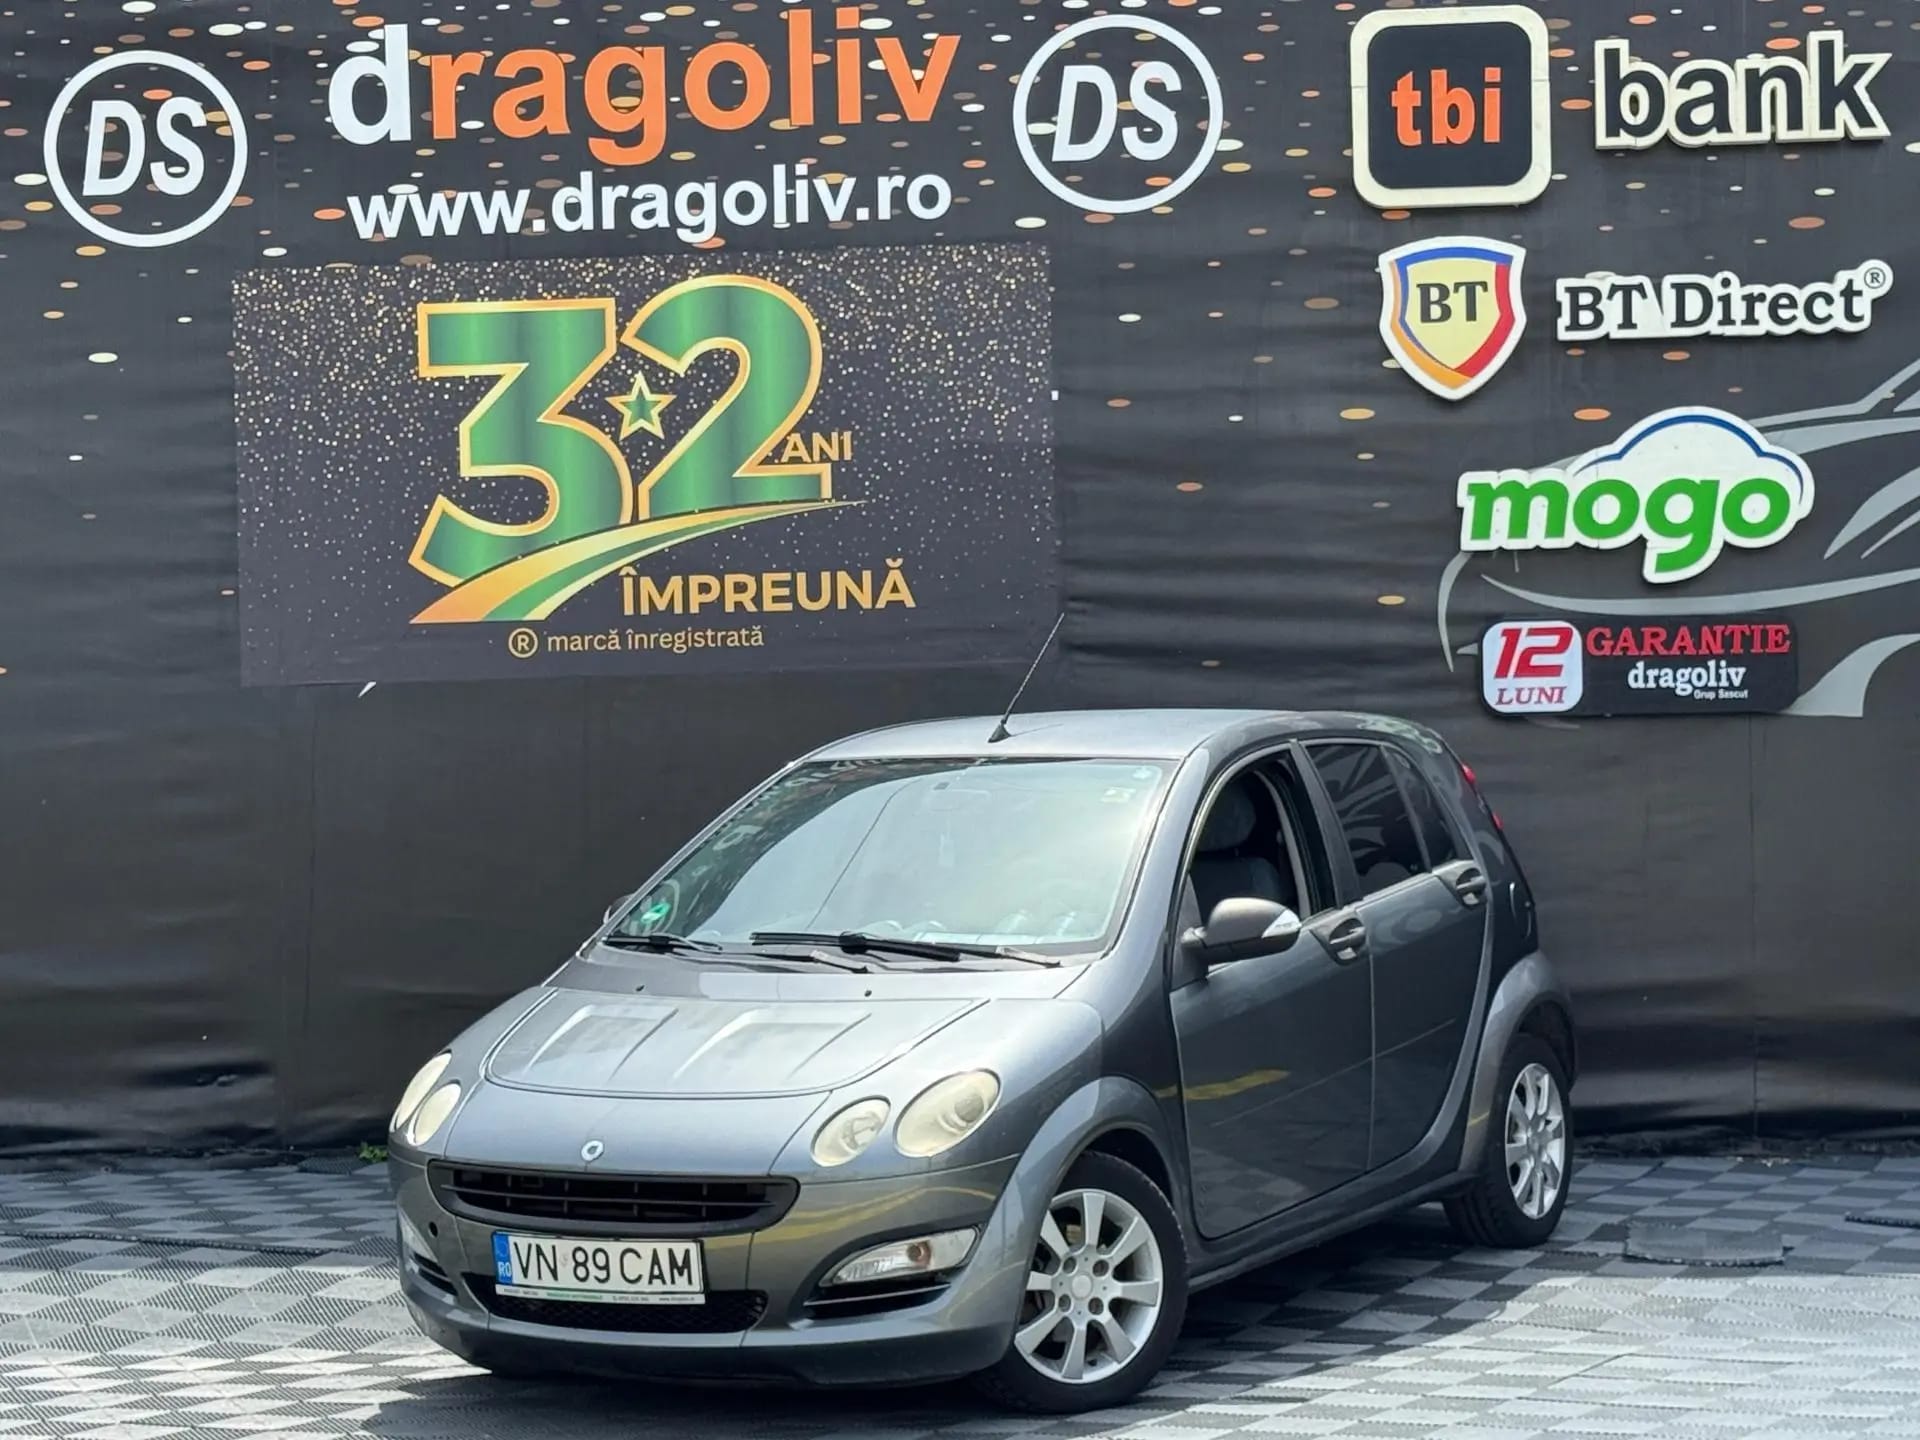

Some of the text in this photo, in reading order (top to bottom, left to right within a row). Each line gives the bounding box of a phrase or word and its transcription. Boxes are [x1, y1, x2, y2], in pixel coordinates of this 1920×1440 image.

[328, 5, 961, 166] dragoliv
[1052, 61, 1182, 162] DS
[1391, 67, 1502, 147] tbi
[1602, 37, 1886, 142] bank
[82, 97, 207, 196] DS
[347, 163, 952, 244] www.dragoliv.ro
[1416, 280, 1488, 324] BT
[1564, 282, 1648, 333] BT
[408, 274, 832, 587] 32
[780, 431, 853, 463] ANI
[1466, 477, 1791, 574] mogo
[618, 558, 916, 617] ÎMPREUNĂ
[547, 627, 621, 653] marcă
[626, 626, 765, 655] înregistrată
[1493, 627, 1574, 680] 12
[1586, 624, 1791, 657] GARANTIE
[1494, 686, 1568, 707] LUNI
[1627, 660, 1747, 697] dragoliv
[498, 1260, 512, 1278] RO
[513, 1241, 694, 1286] VN 89 CAM
